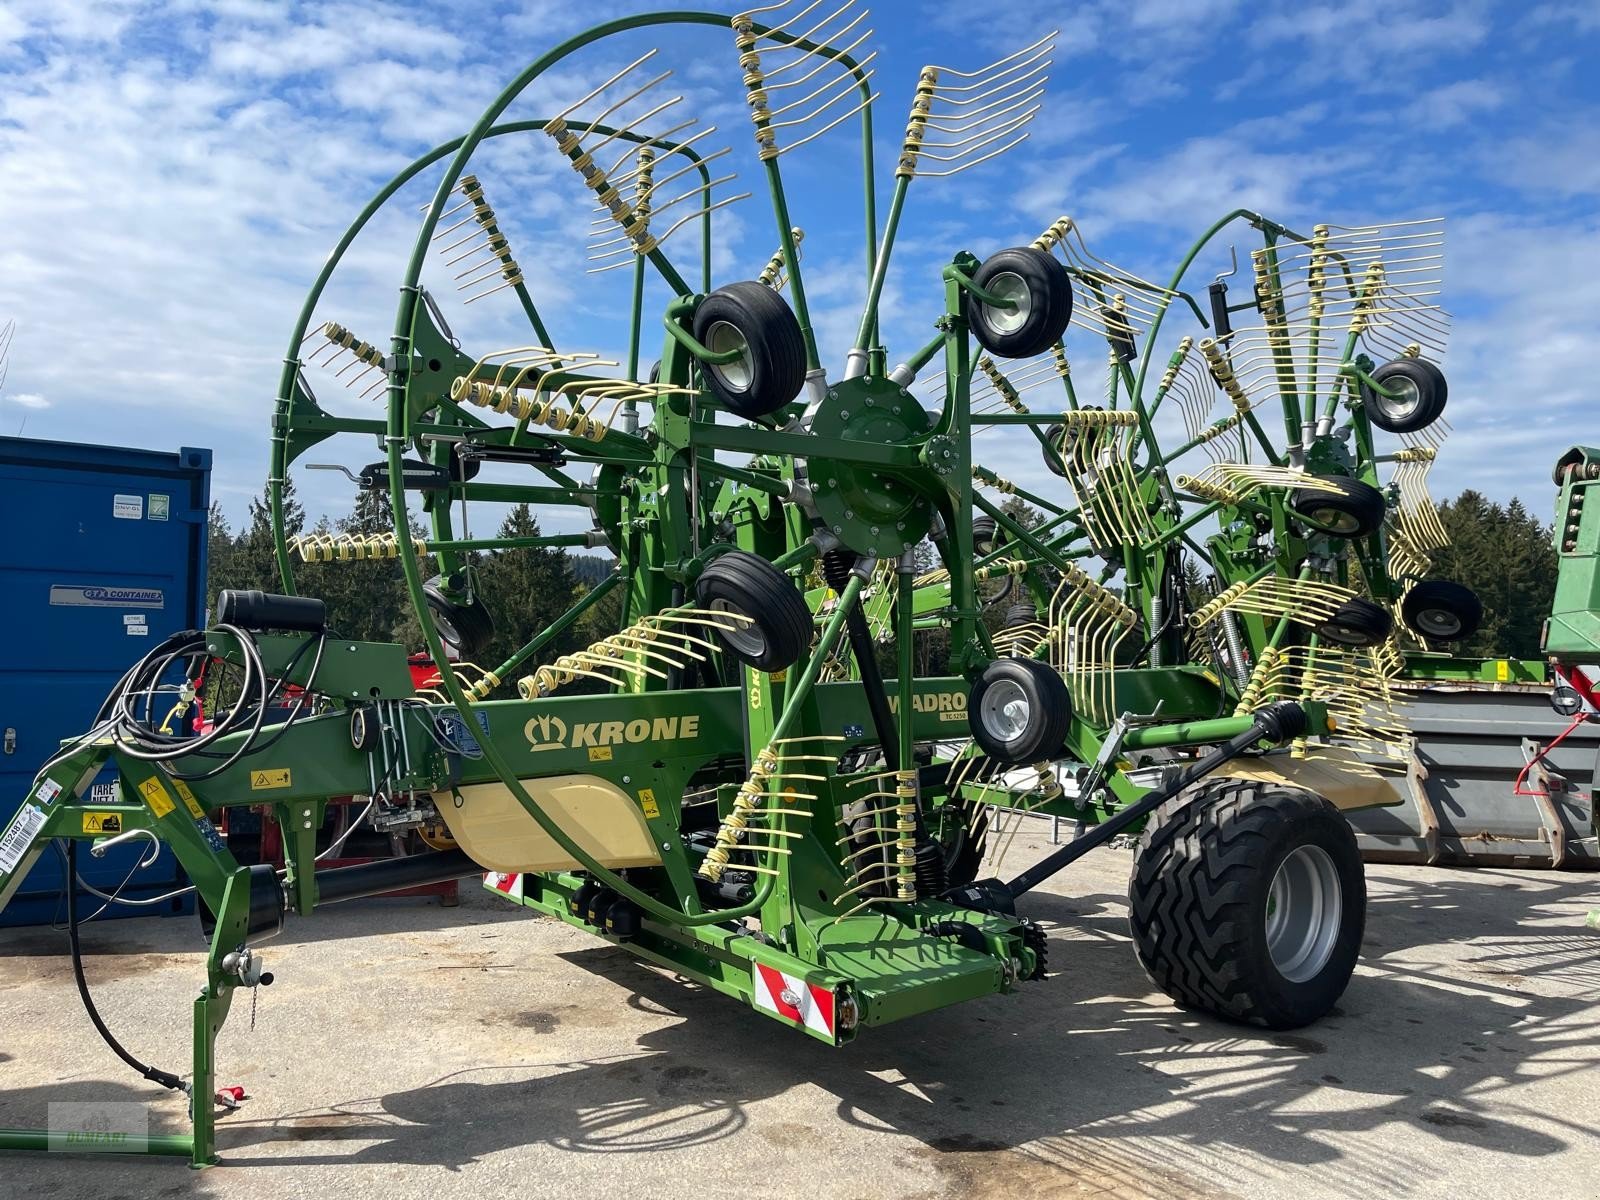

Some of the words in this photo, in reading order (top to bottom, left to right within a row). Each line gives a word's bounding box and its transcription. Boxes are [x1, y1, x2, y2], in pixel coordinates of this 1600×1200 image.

[110, 590, 162, 600] CONTAINEX
[886, 692, 967, 714] WADRO
[571, 716, 699, 748] KRONE
